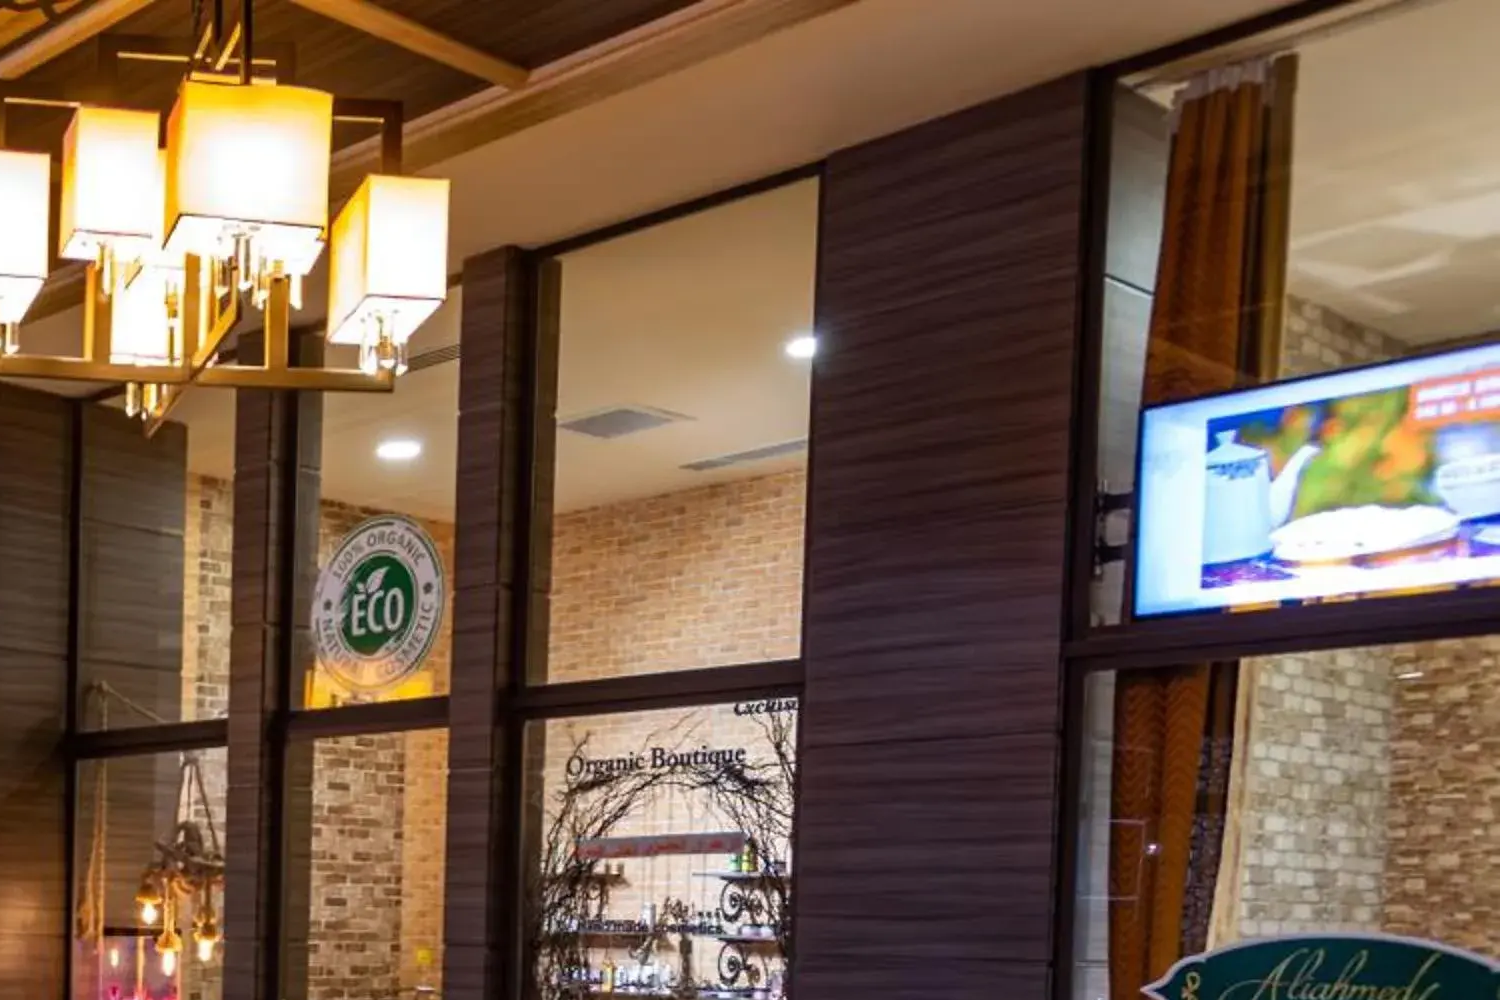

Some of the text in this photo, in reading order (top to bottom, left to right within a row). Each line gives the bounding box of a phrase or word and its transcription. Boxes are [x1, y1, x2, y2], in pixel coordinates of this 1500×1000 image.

[367, 529, 426, 567] ORGANIC
[352, 587, 404, 637] ECO
[566, 745, 746, 779] Organic Boutique
